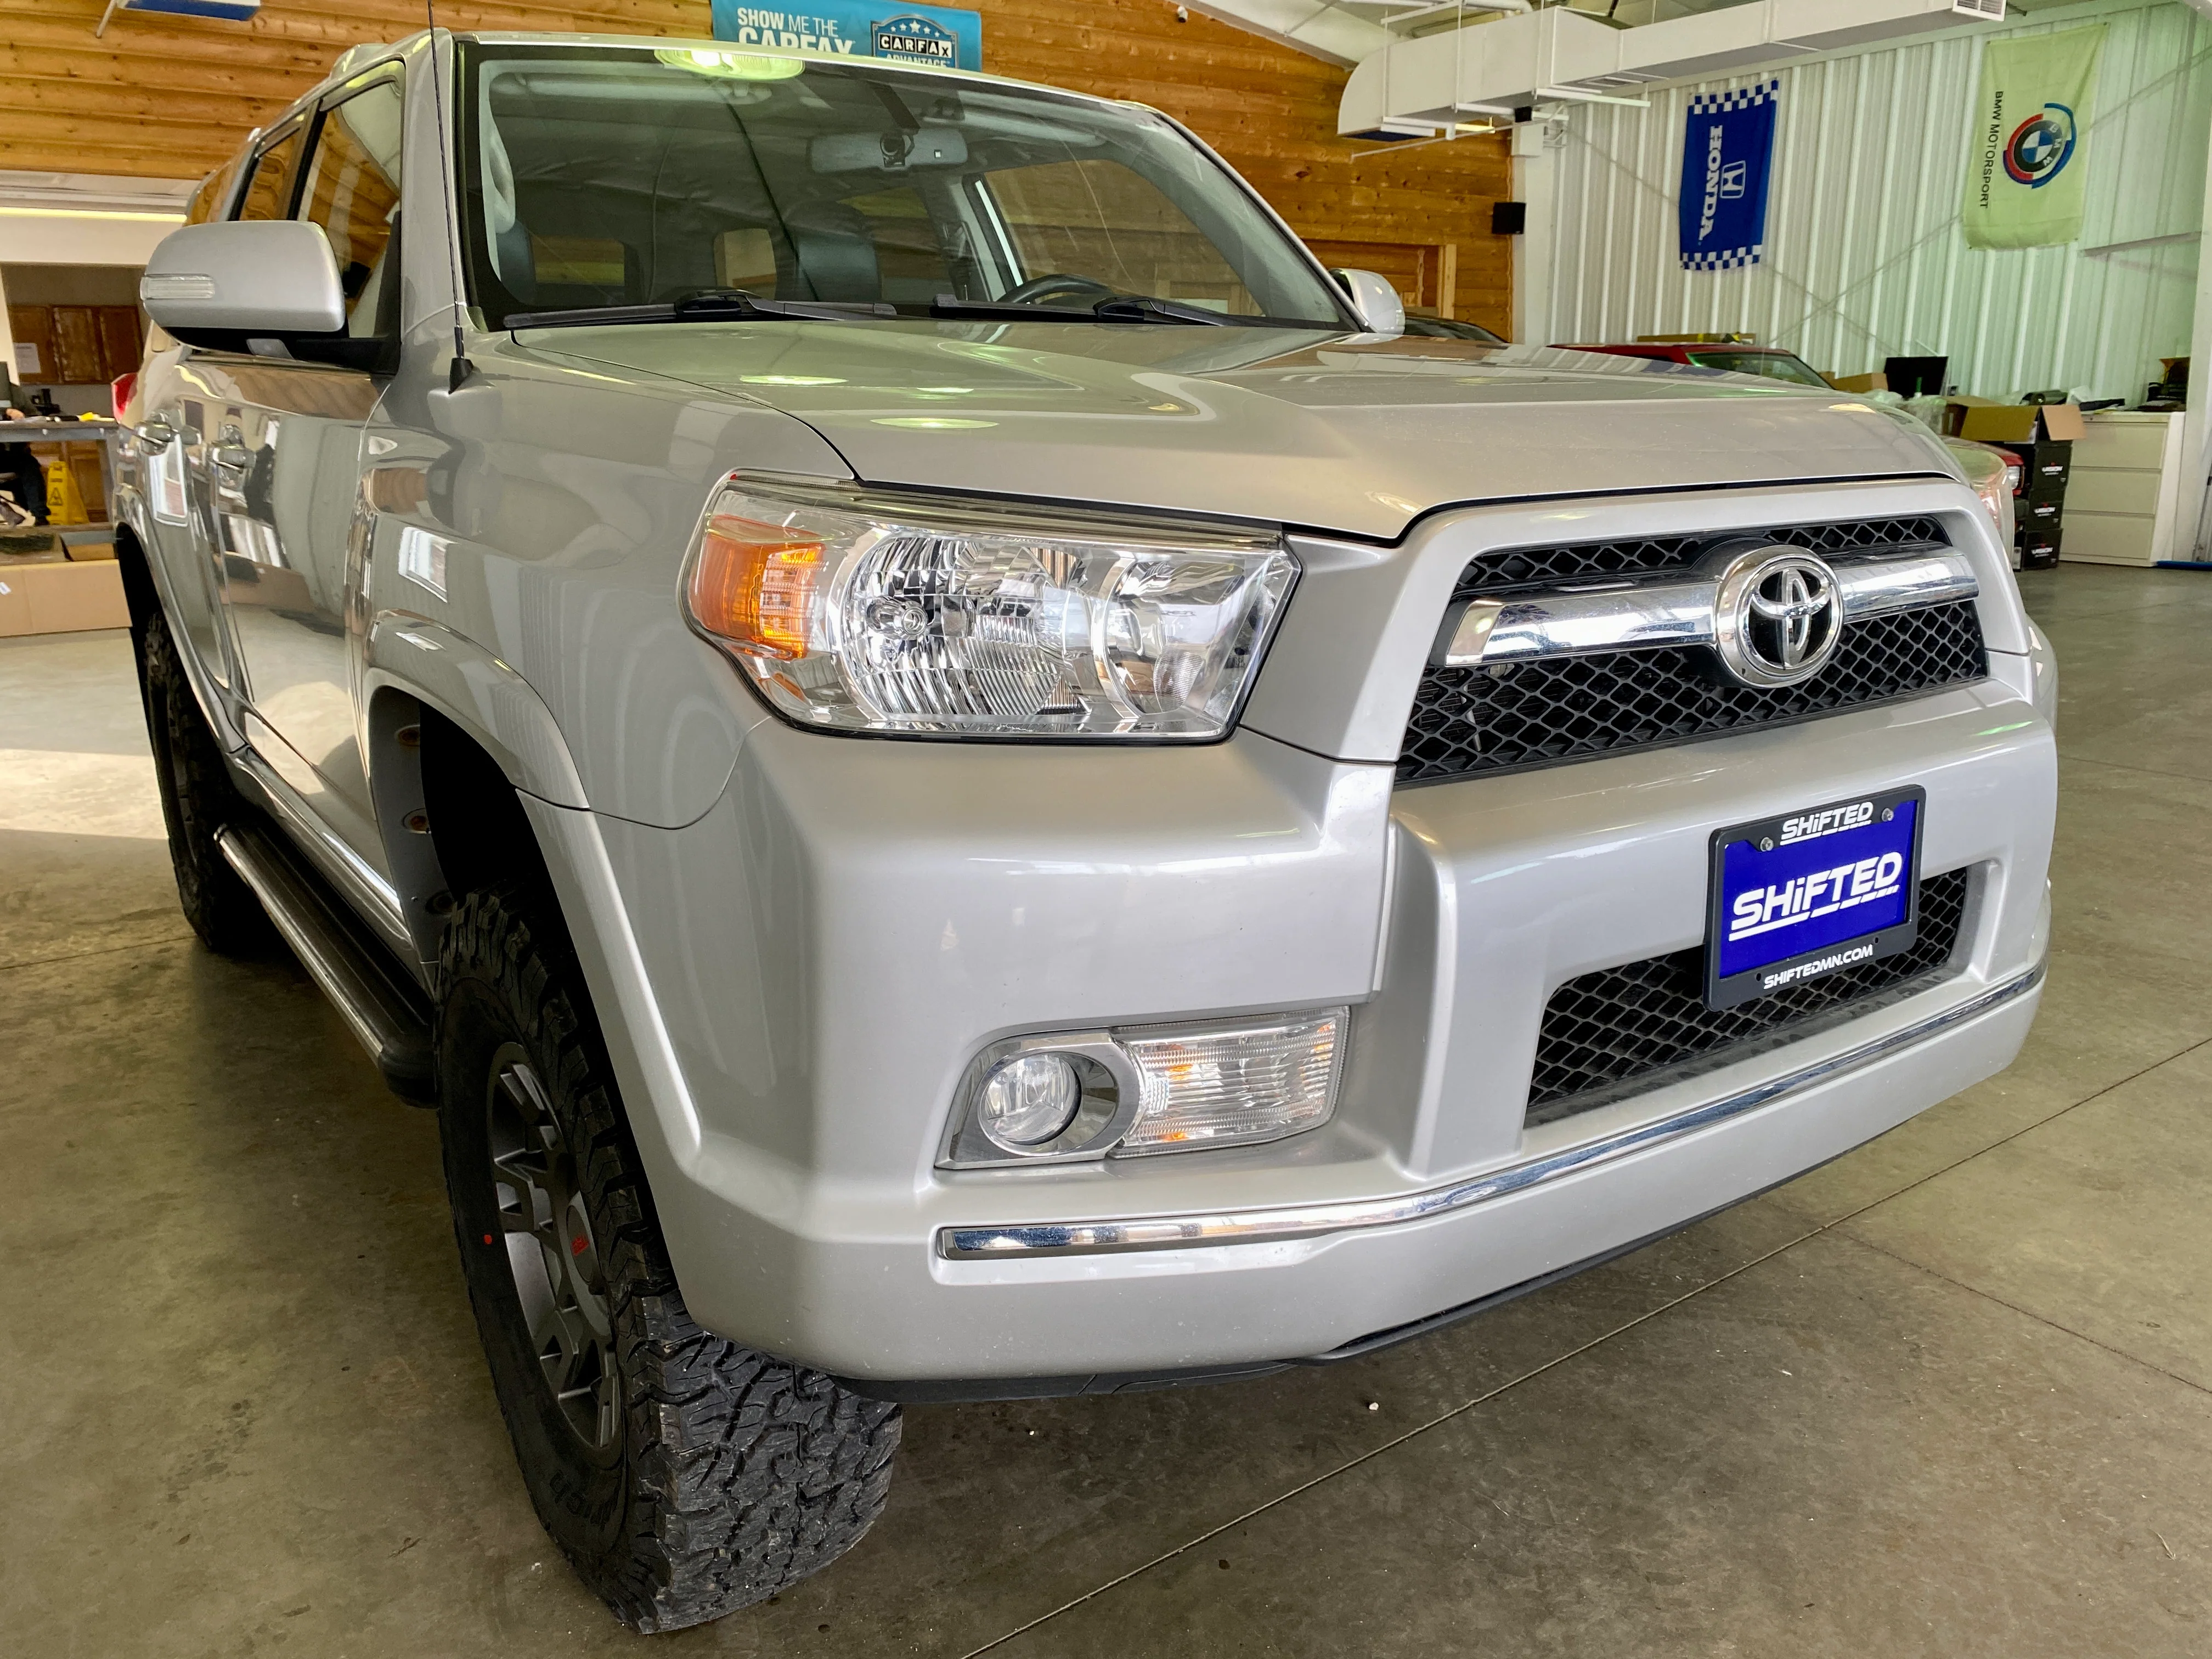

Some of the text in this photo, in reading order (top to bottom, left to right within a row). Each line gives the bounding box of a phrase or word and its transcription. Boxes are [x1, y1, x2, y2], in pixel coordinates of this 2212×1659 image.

[737, 8, 838, 37] SHOW ME THE
[881, 36, 949, 57] CARFAX
[1980, 91, 2004, 208] BMW MOTORSPORT
[1699, 125, 1723, 240] HONDA
[1763, 944, 1874, 990] SHIFTEDMN.COM
